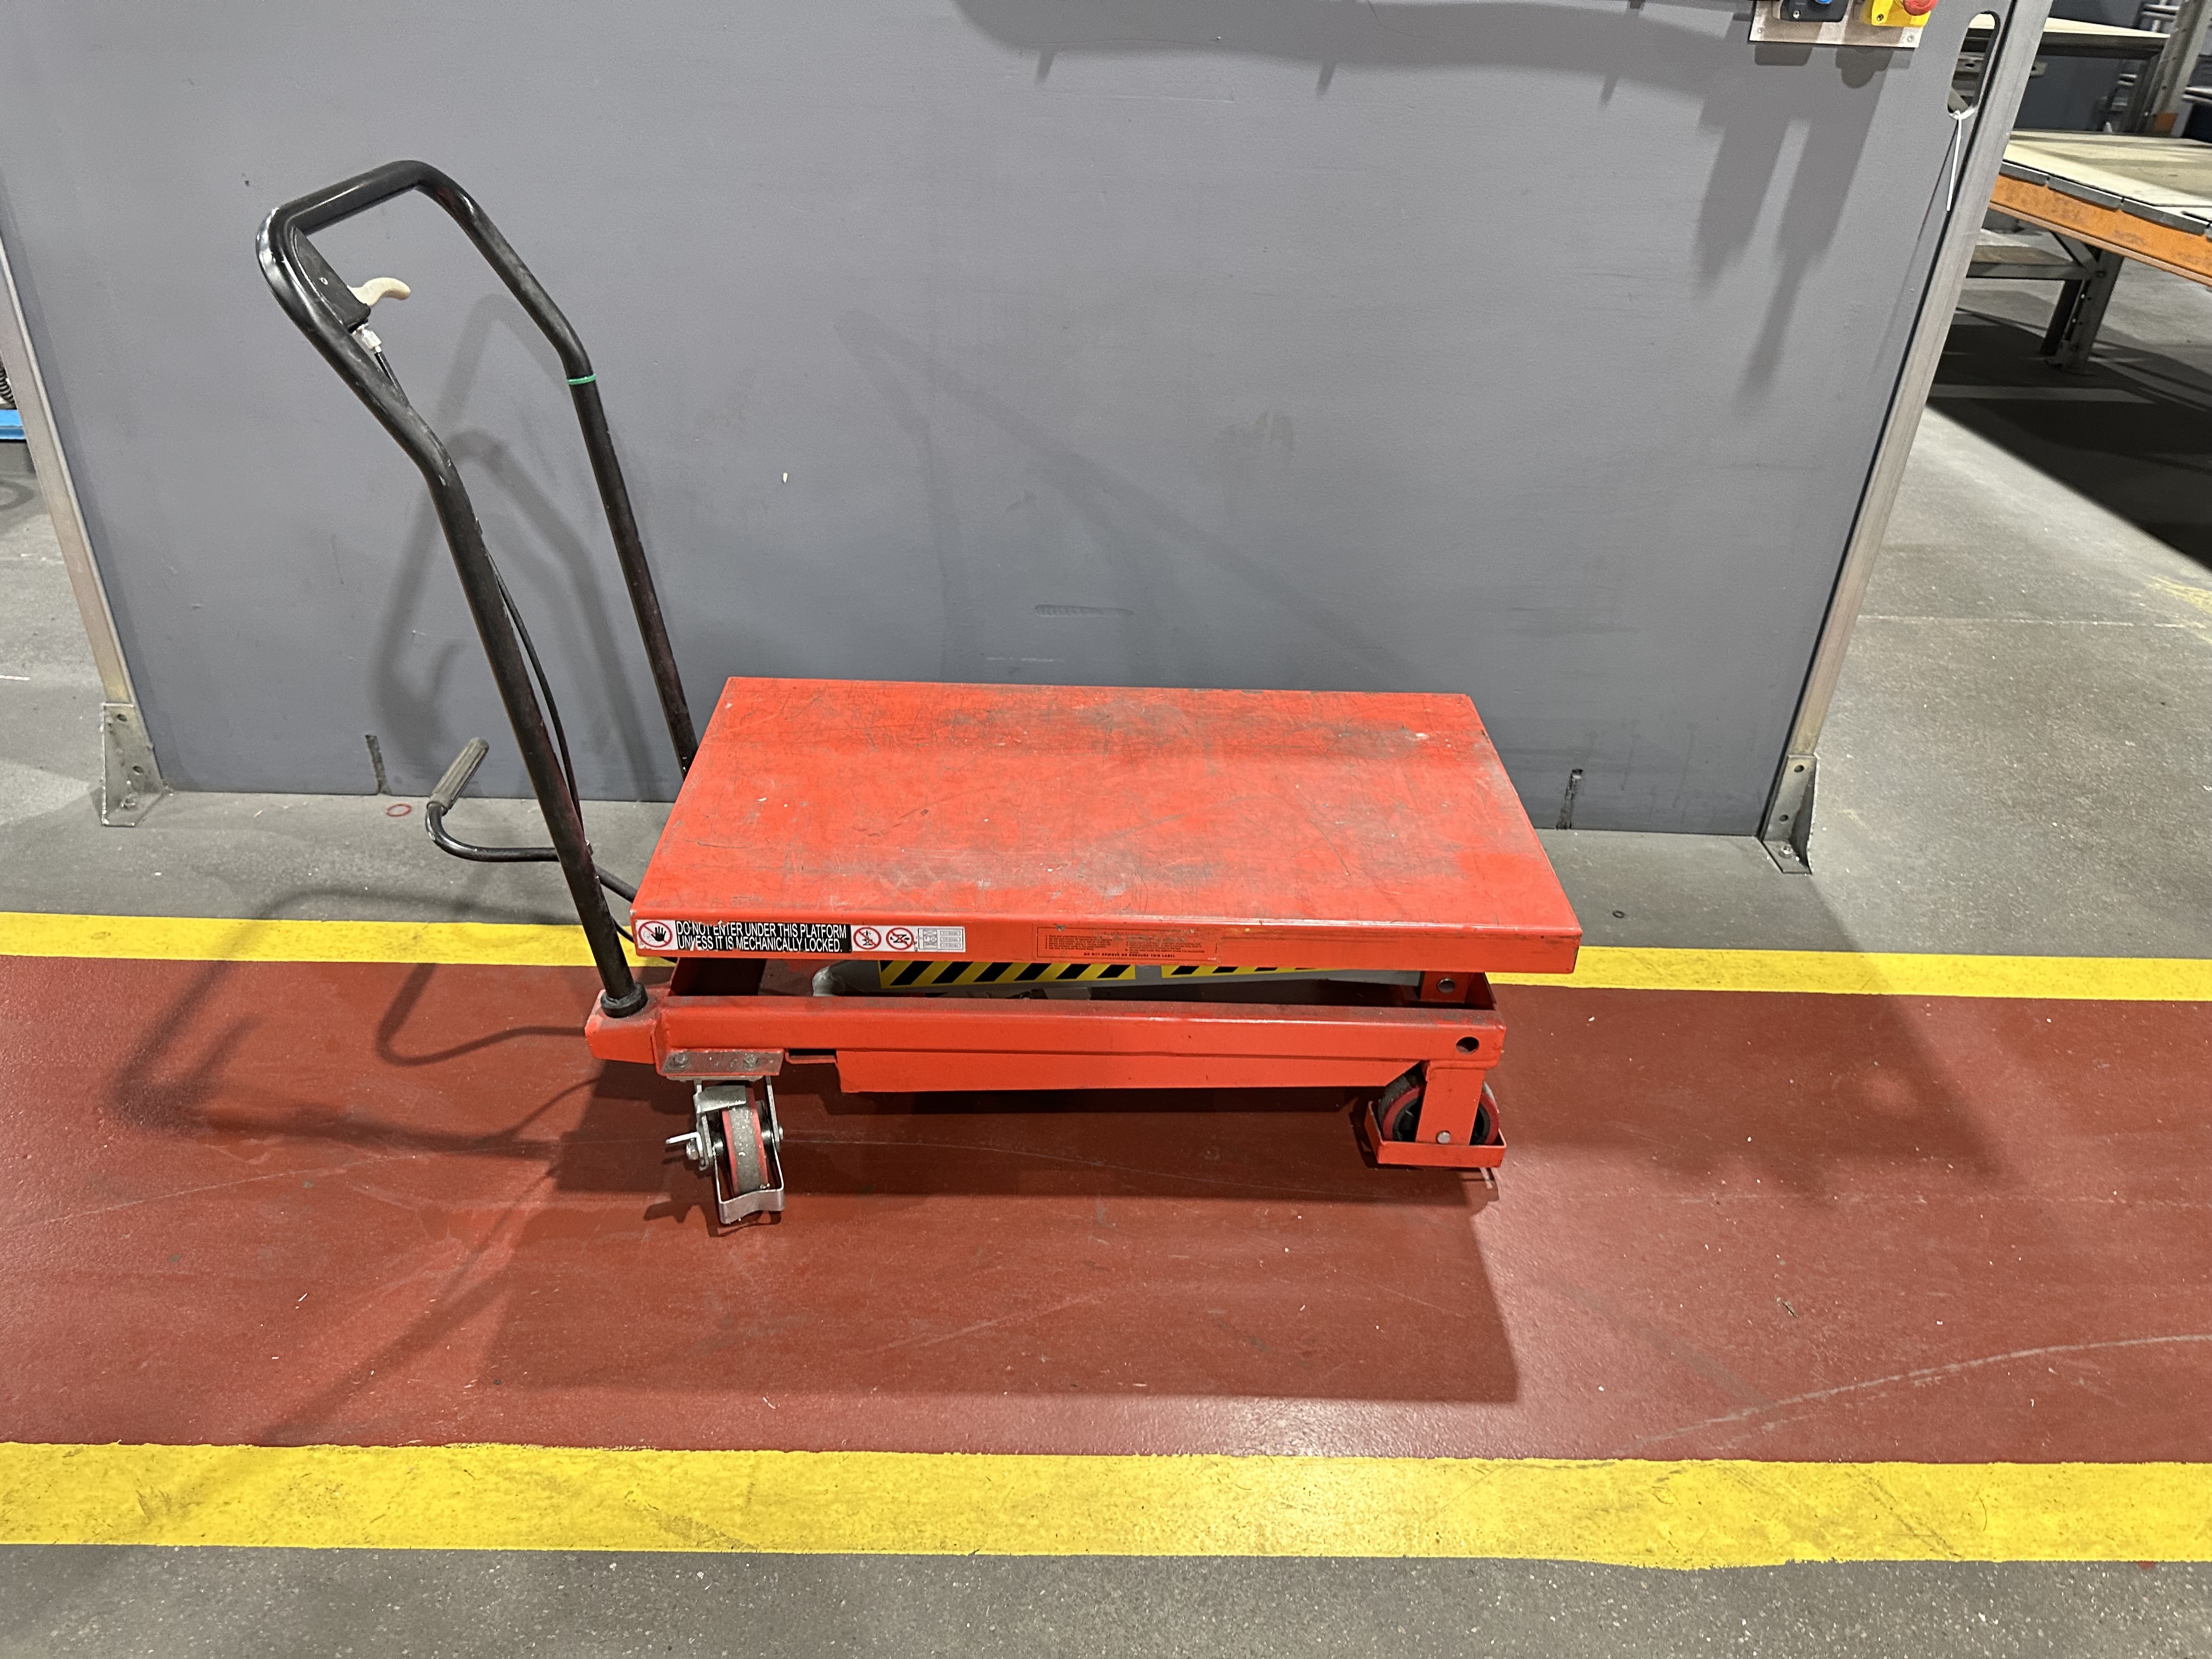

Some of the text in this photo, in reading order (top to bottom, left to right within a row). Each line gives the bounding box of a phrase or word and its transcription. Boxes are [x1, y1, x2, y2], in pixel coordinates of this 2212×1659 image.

[676, 921, 847, 939] DO NOT ENTER UNDER THIS PLATFORM
[715, 936, 723, 950] IT
[725, 936, 734, 950] IS
[736, 936, 803, 951] MECHANICALLY
[804, 937, 843, 952] LOCKED.
